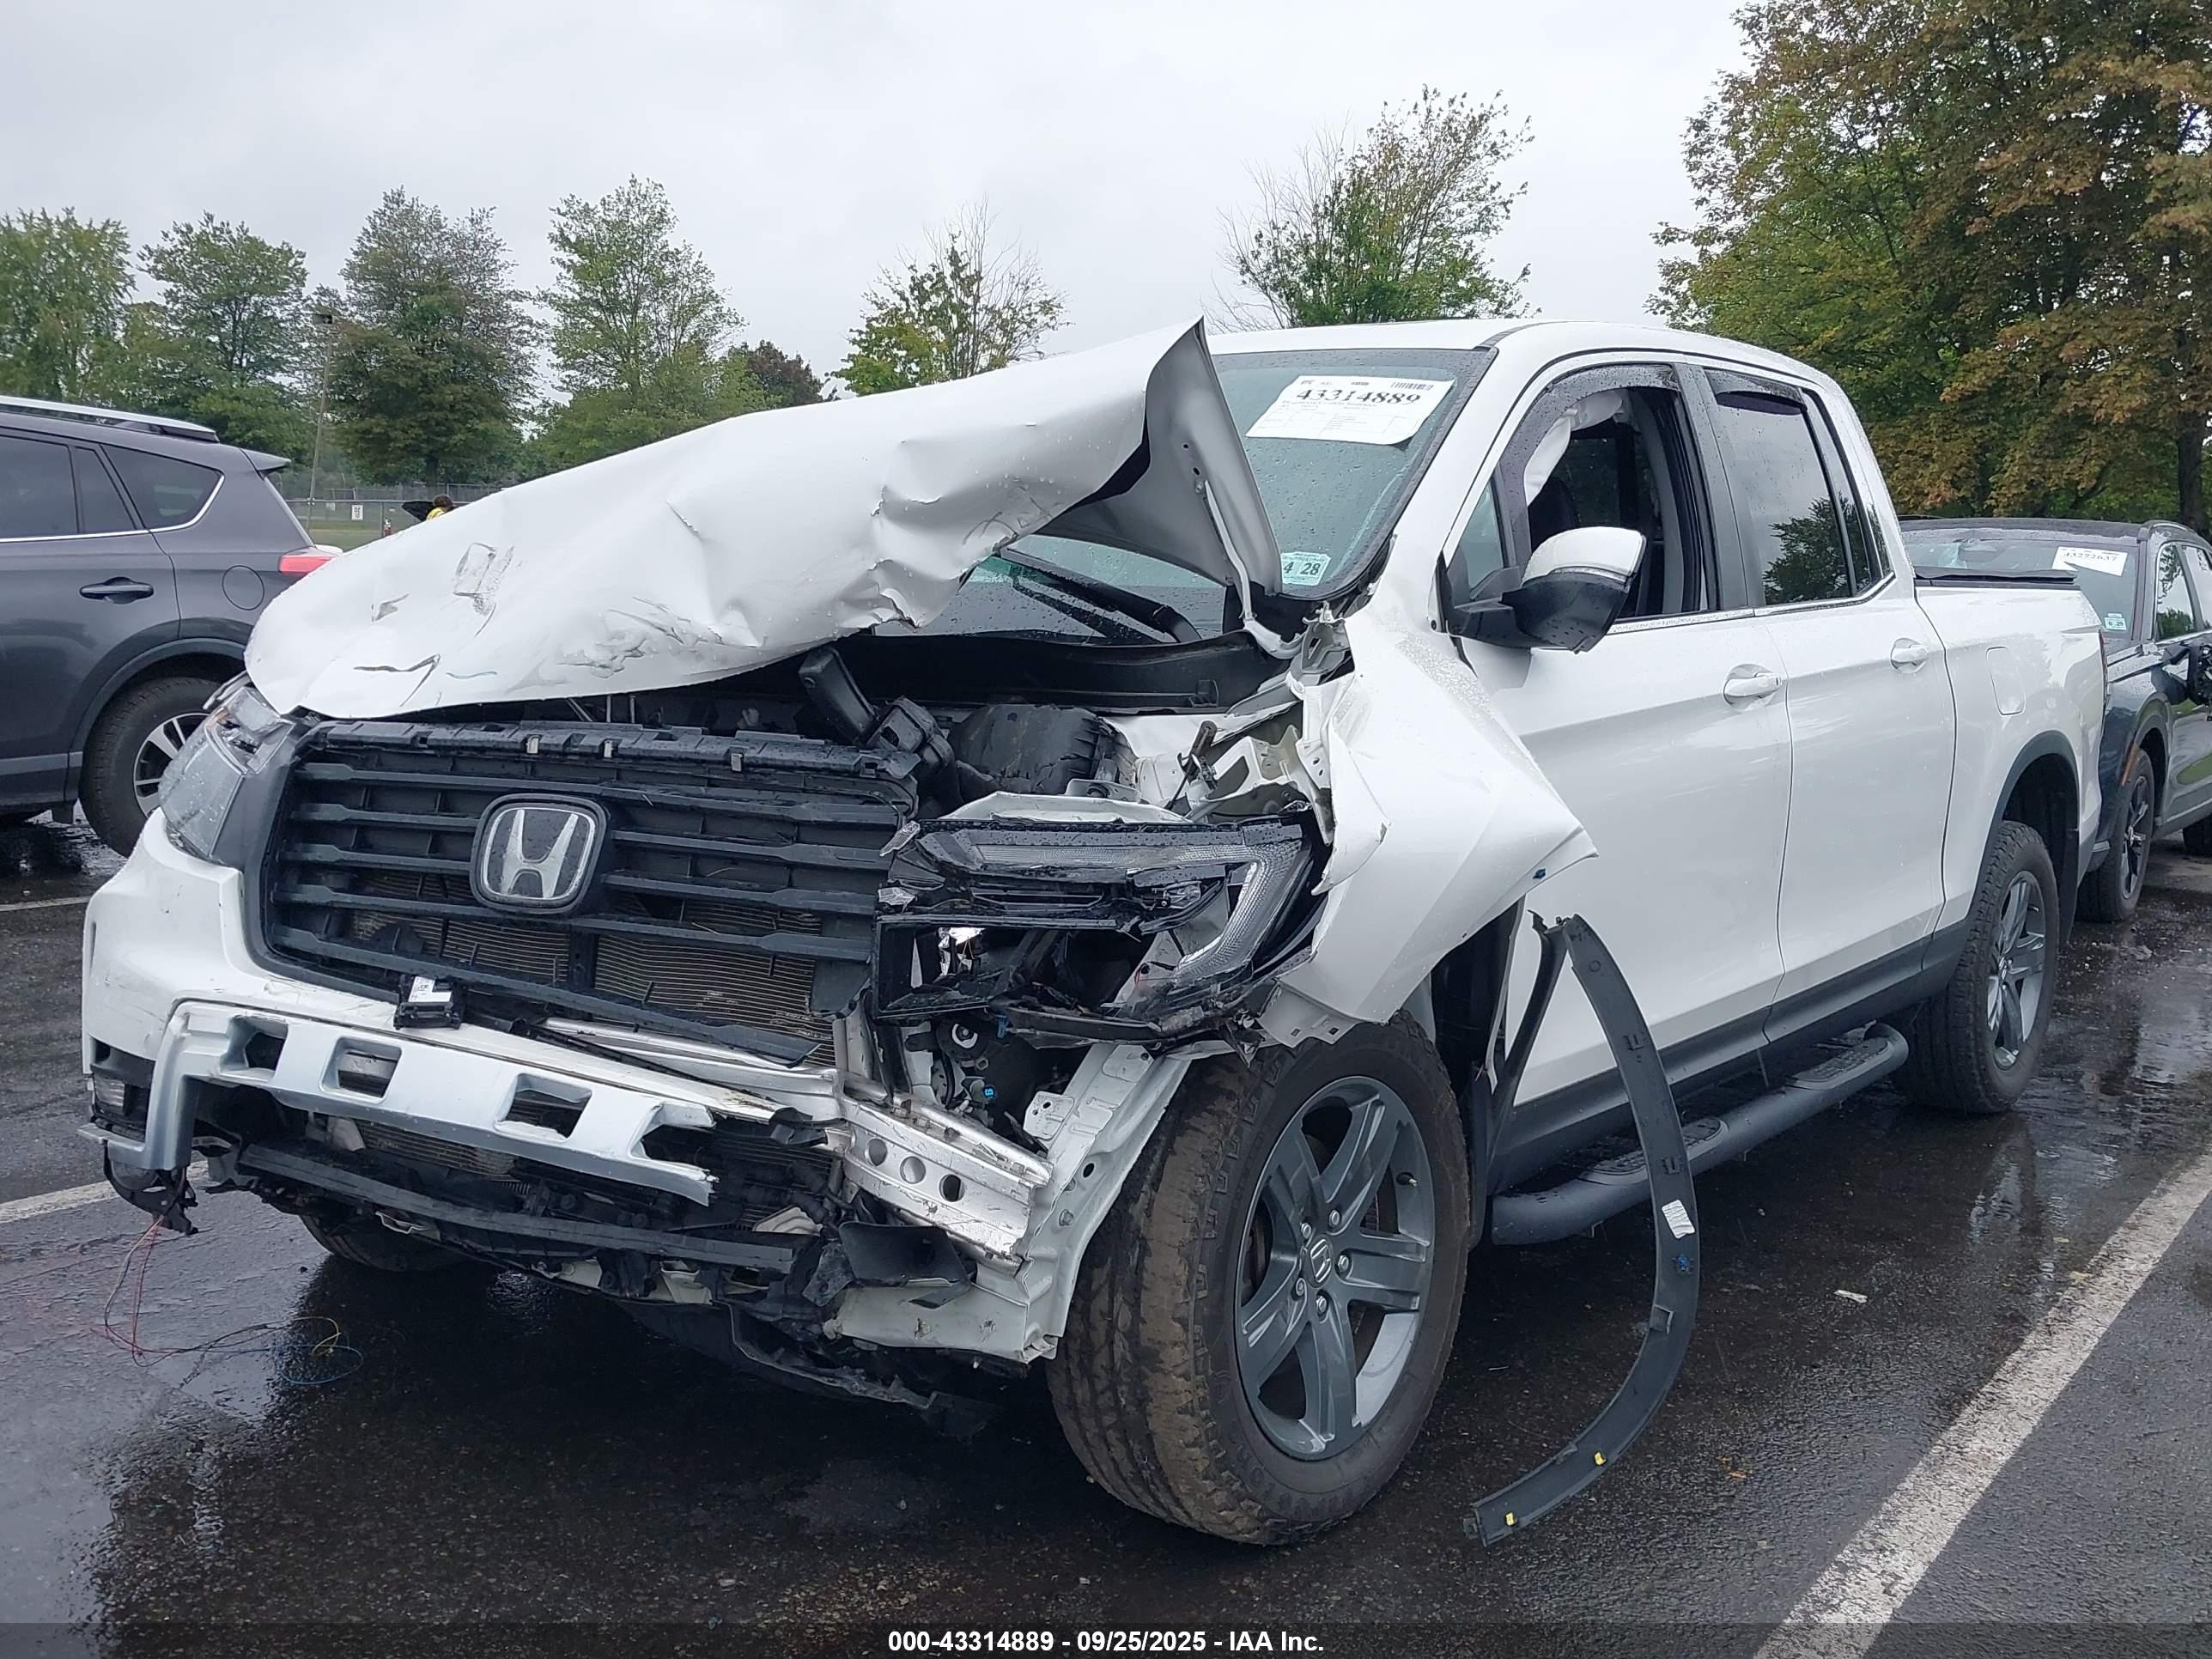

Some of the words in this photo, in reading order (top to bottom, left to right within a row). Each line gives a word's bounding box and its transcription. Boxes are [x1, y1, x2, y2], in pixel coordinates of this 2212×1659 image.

[1297, 389, 1421, 405] 43314889
[1283, 561, 1295, 574] 4
[1300, 562, 1321, 575] 28
